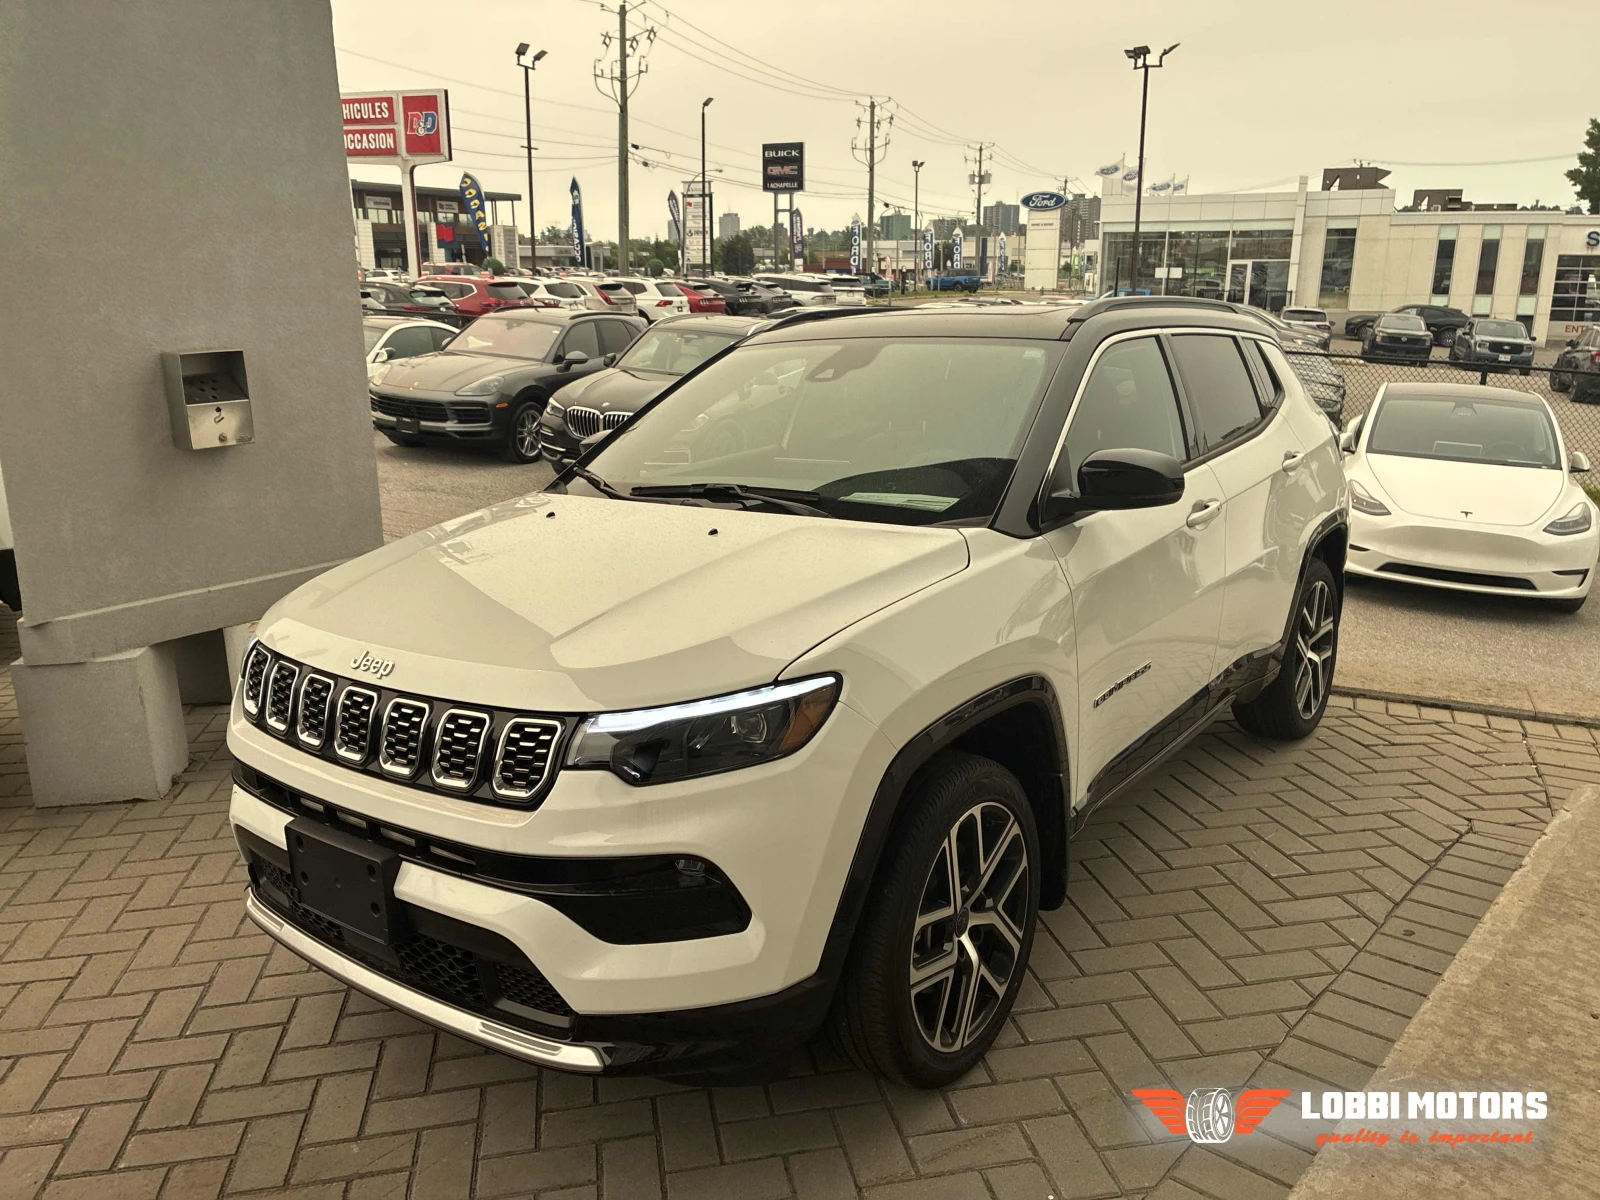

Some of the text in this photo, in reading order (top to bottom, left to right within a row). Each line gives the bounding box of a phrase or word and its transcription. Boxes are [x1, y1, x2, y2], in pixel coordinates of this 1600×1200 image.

[767, 165, 798, 175] GMC
[1029, 194, 1056, 207] Ford
[1565, 325, 1588, 333] ENT
[350, 650, 395, 679] Jeep
